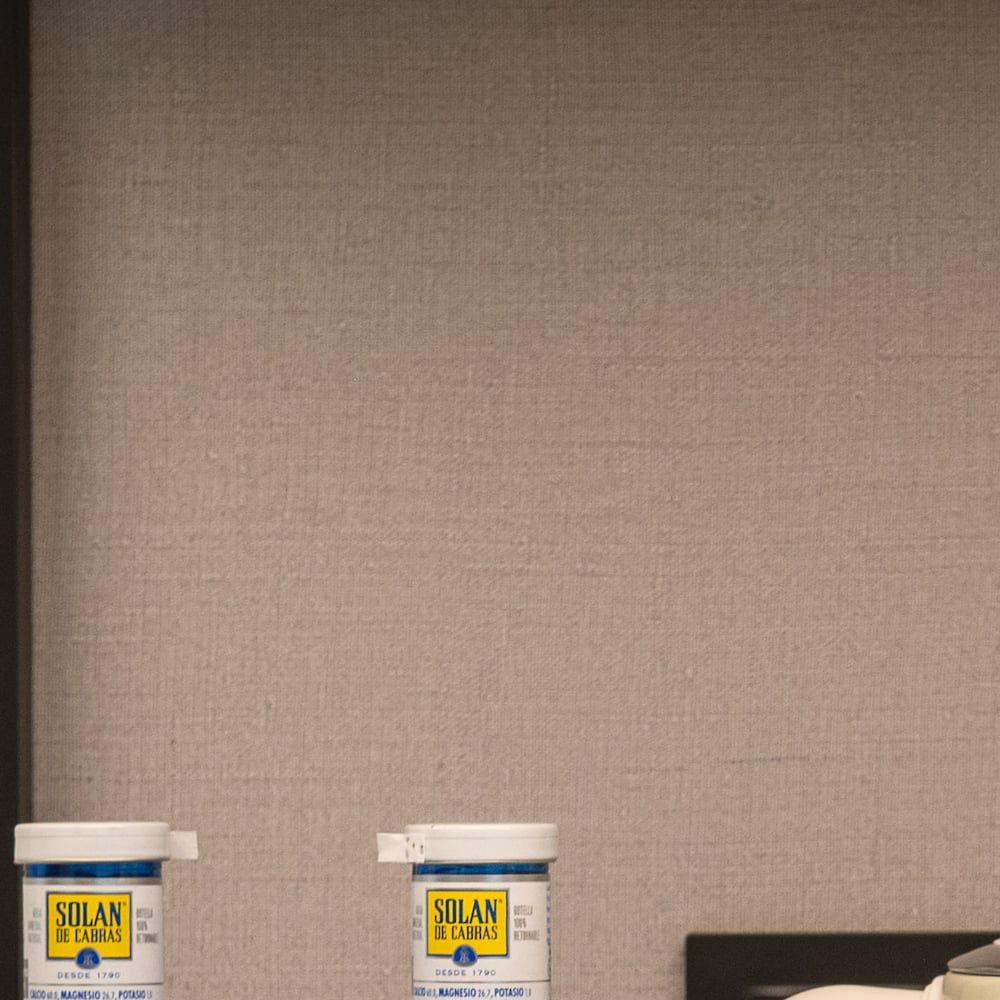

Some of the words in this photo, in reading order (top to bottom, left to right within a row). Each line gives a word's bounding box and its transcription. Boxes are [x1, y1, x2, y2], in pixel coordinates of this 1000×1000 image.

[56, 901, 122, 927] SOLAN
[434, 899, 498, 925] SOLAN
[56, 928, 70, 943] DE
[75, 928, 122, 943] CABRAS
[434, 925, 447, 940] DE
[451, 925, 498, 940] CABRAS
[57, 971, 91, 979] DESDE
[97, 971, 121, 979] 1790
[435, 969, 467, 977] DESDE
[60, 990, 101, 1000] MAGNESIO
[118, 989, 146, 1000] POTASIO
[438, 986, 477, 998] MAGNESIO
[494, 986, 524, 997] POTASIO
